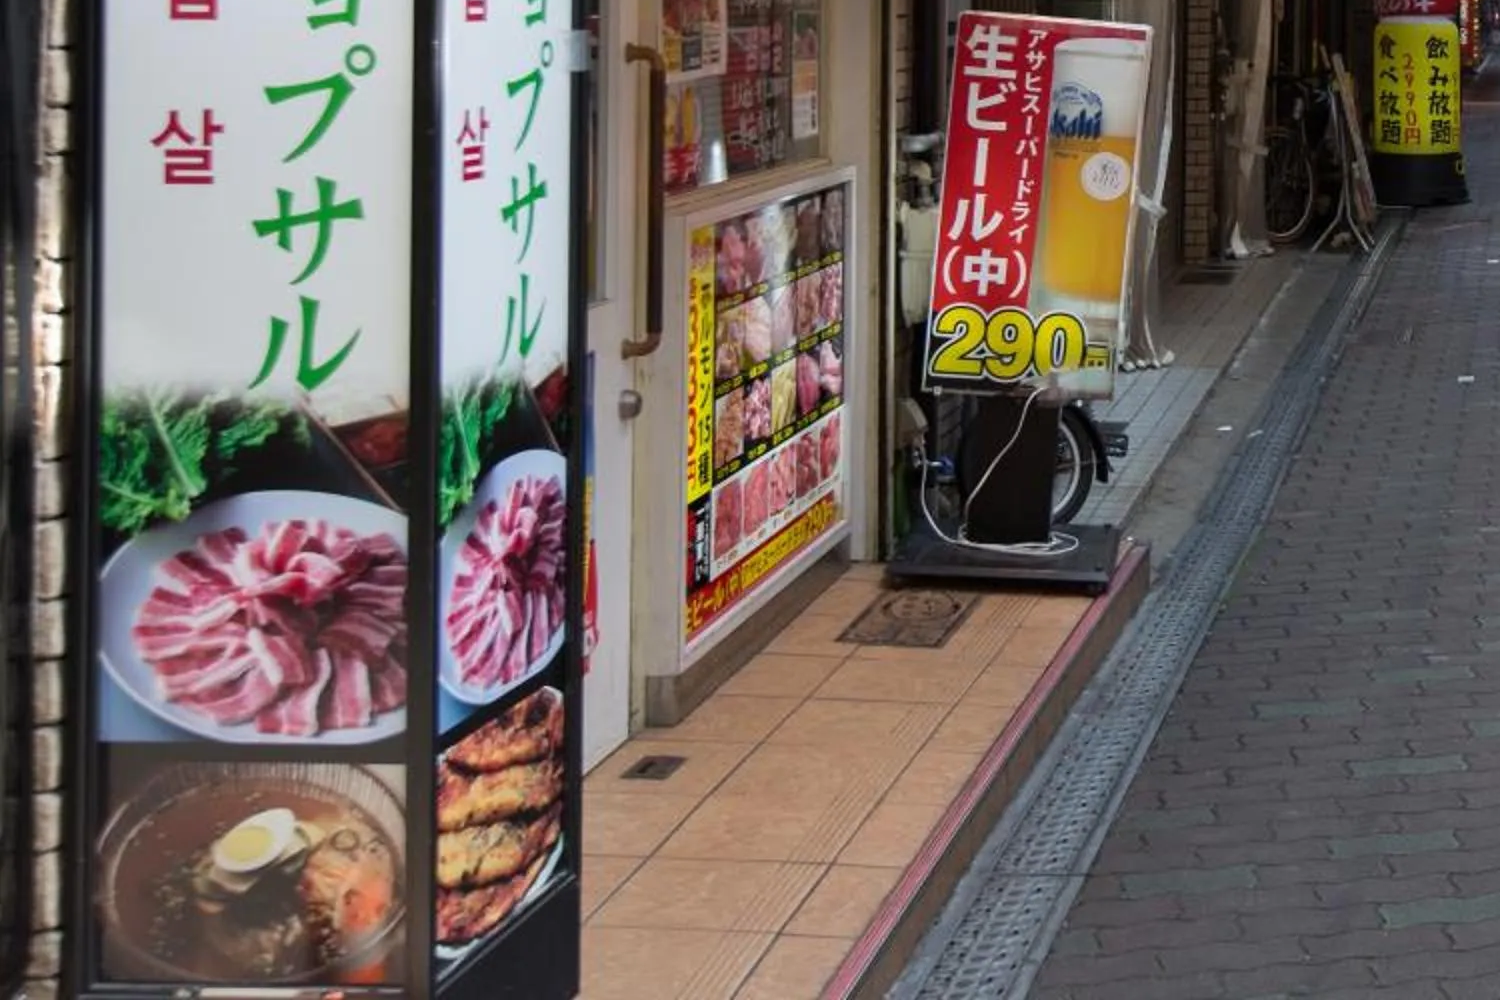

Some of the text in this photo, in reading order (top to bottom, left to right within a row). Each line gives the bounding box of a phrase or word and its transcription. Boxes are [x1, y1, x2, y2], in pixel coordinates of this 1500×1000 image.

[938, 23, 1031, 300] 生ビール(中)
[1007, 28, 1048, 244] アサヒスーパードライ
[1378, 33, 1401, 145] 食べ放題
[1425, 33, 1452, 146] 飲み放題
